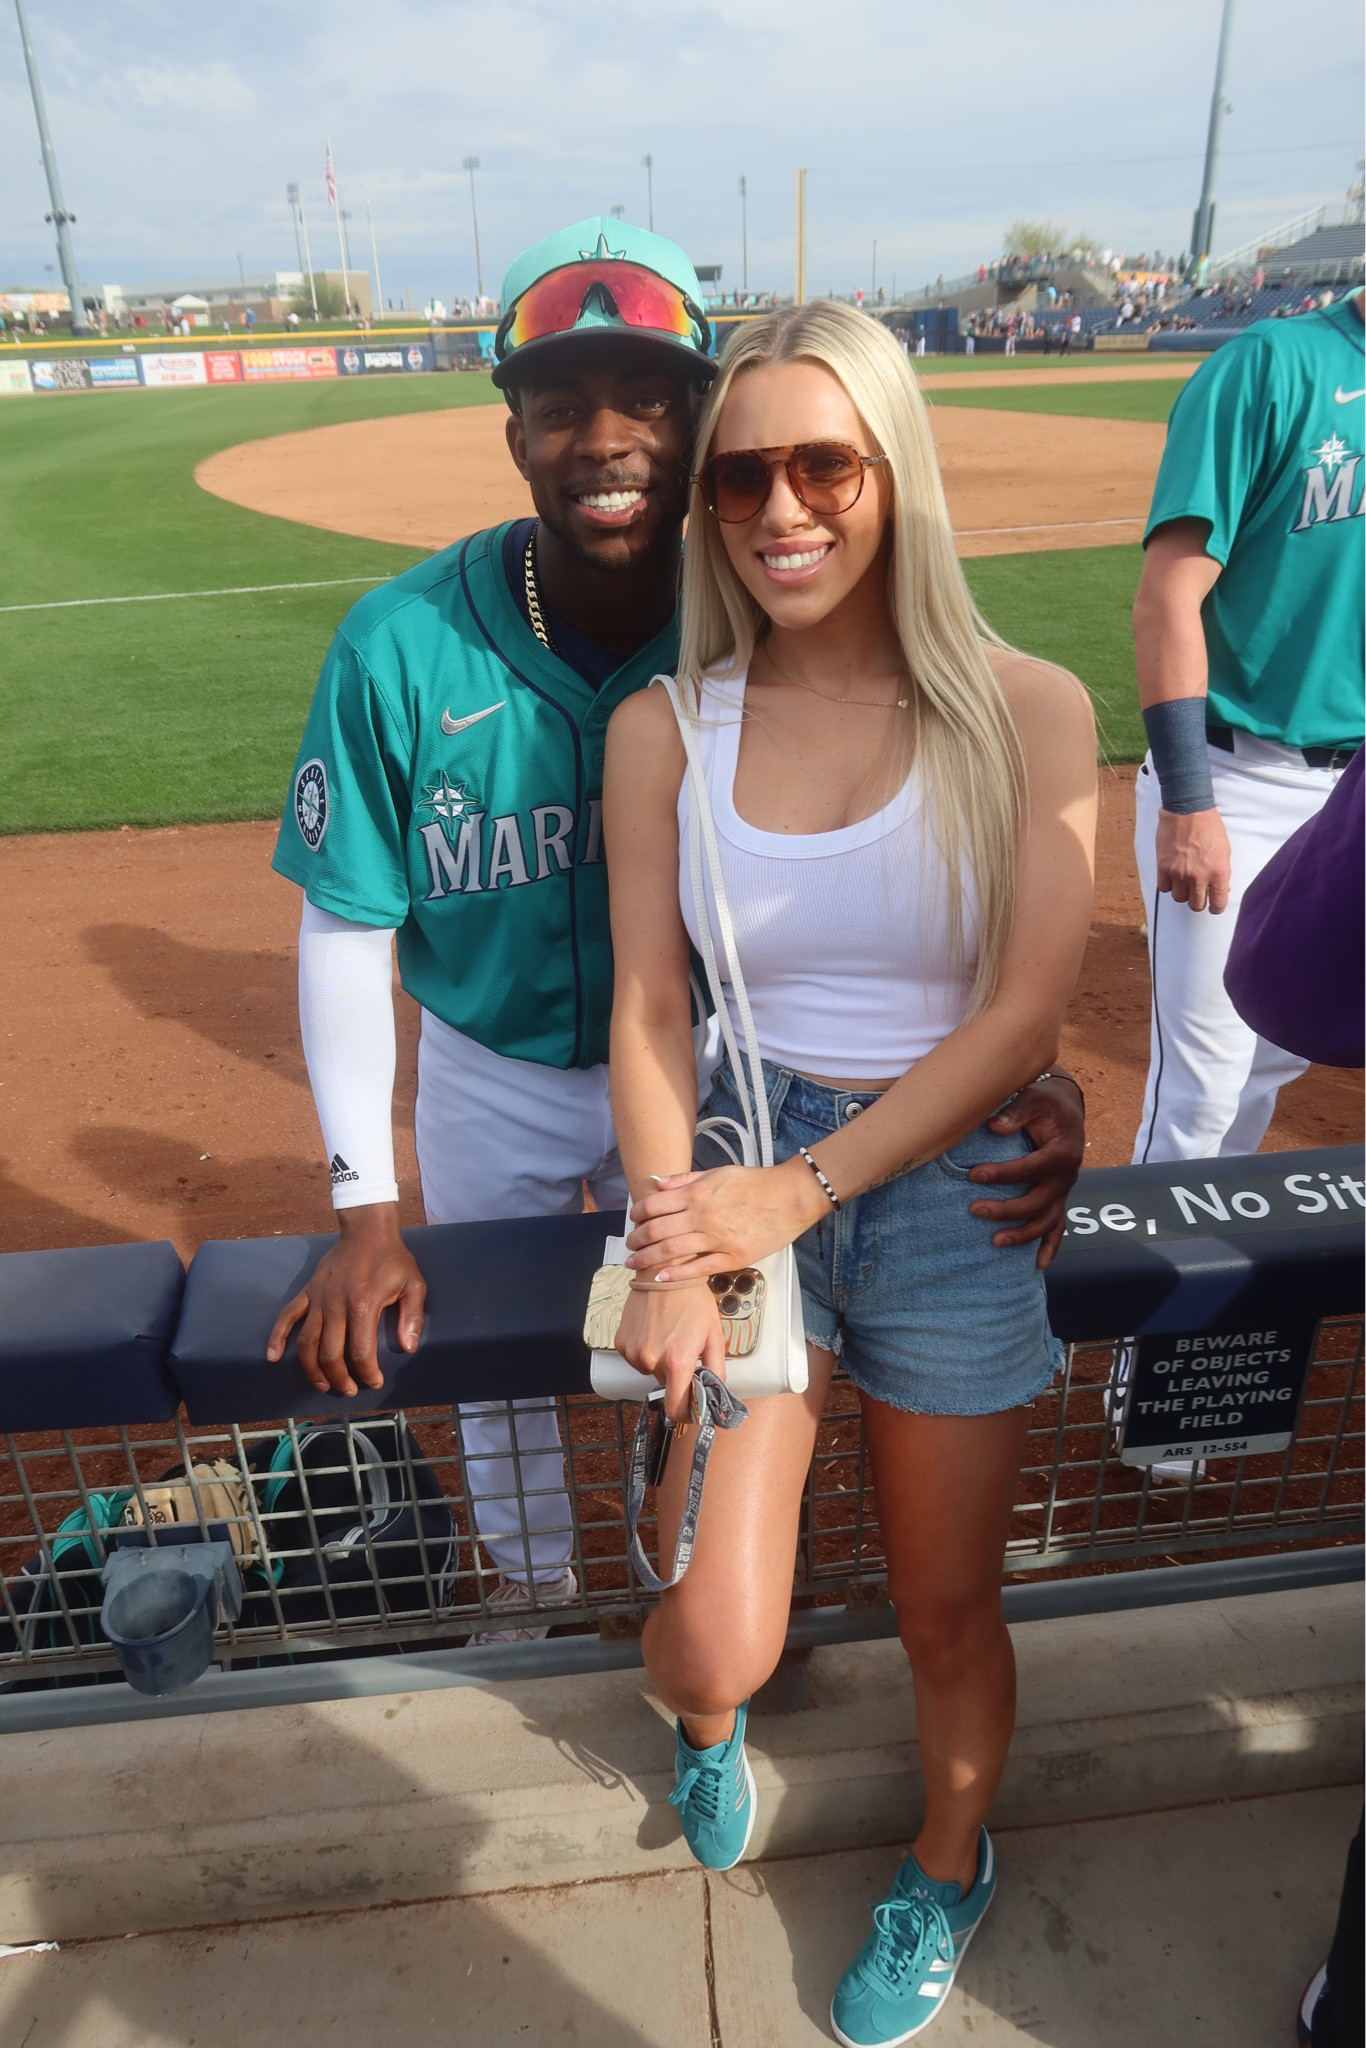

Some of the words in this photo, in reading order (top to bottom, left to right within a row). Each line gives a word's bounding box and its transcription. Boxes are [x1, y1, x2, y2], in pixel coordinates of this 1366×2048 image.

[301, 767, 325, 804] SEATTLE
[298, 805, 321, 842] MARINERS
[1063, 1203, 1157, 1236] se,
[1169, 1183, 1270, 1224] No
[1175, 1331, 1277, 1352] BEWARE
[1153, 1359, 1184, 1374] OF
[1191, 1349, 1291, 1371] OBJECTS
[1168, 1371, 1269, 1392] LEAVING
[1137, 1399, 1184, 1414] THE
[1191, 1388, 1292, 1410] PLAYING
[1179, 1412, 1243, 1429] FIELD
[1163, 1447, 1193, 1457] ARS
[1202, 1442, 1248, 1454] 12-554
[690, 1469, 703, 1490] WAR
[678, 1543, 692, 1562] WAR
